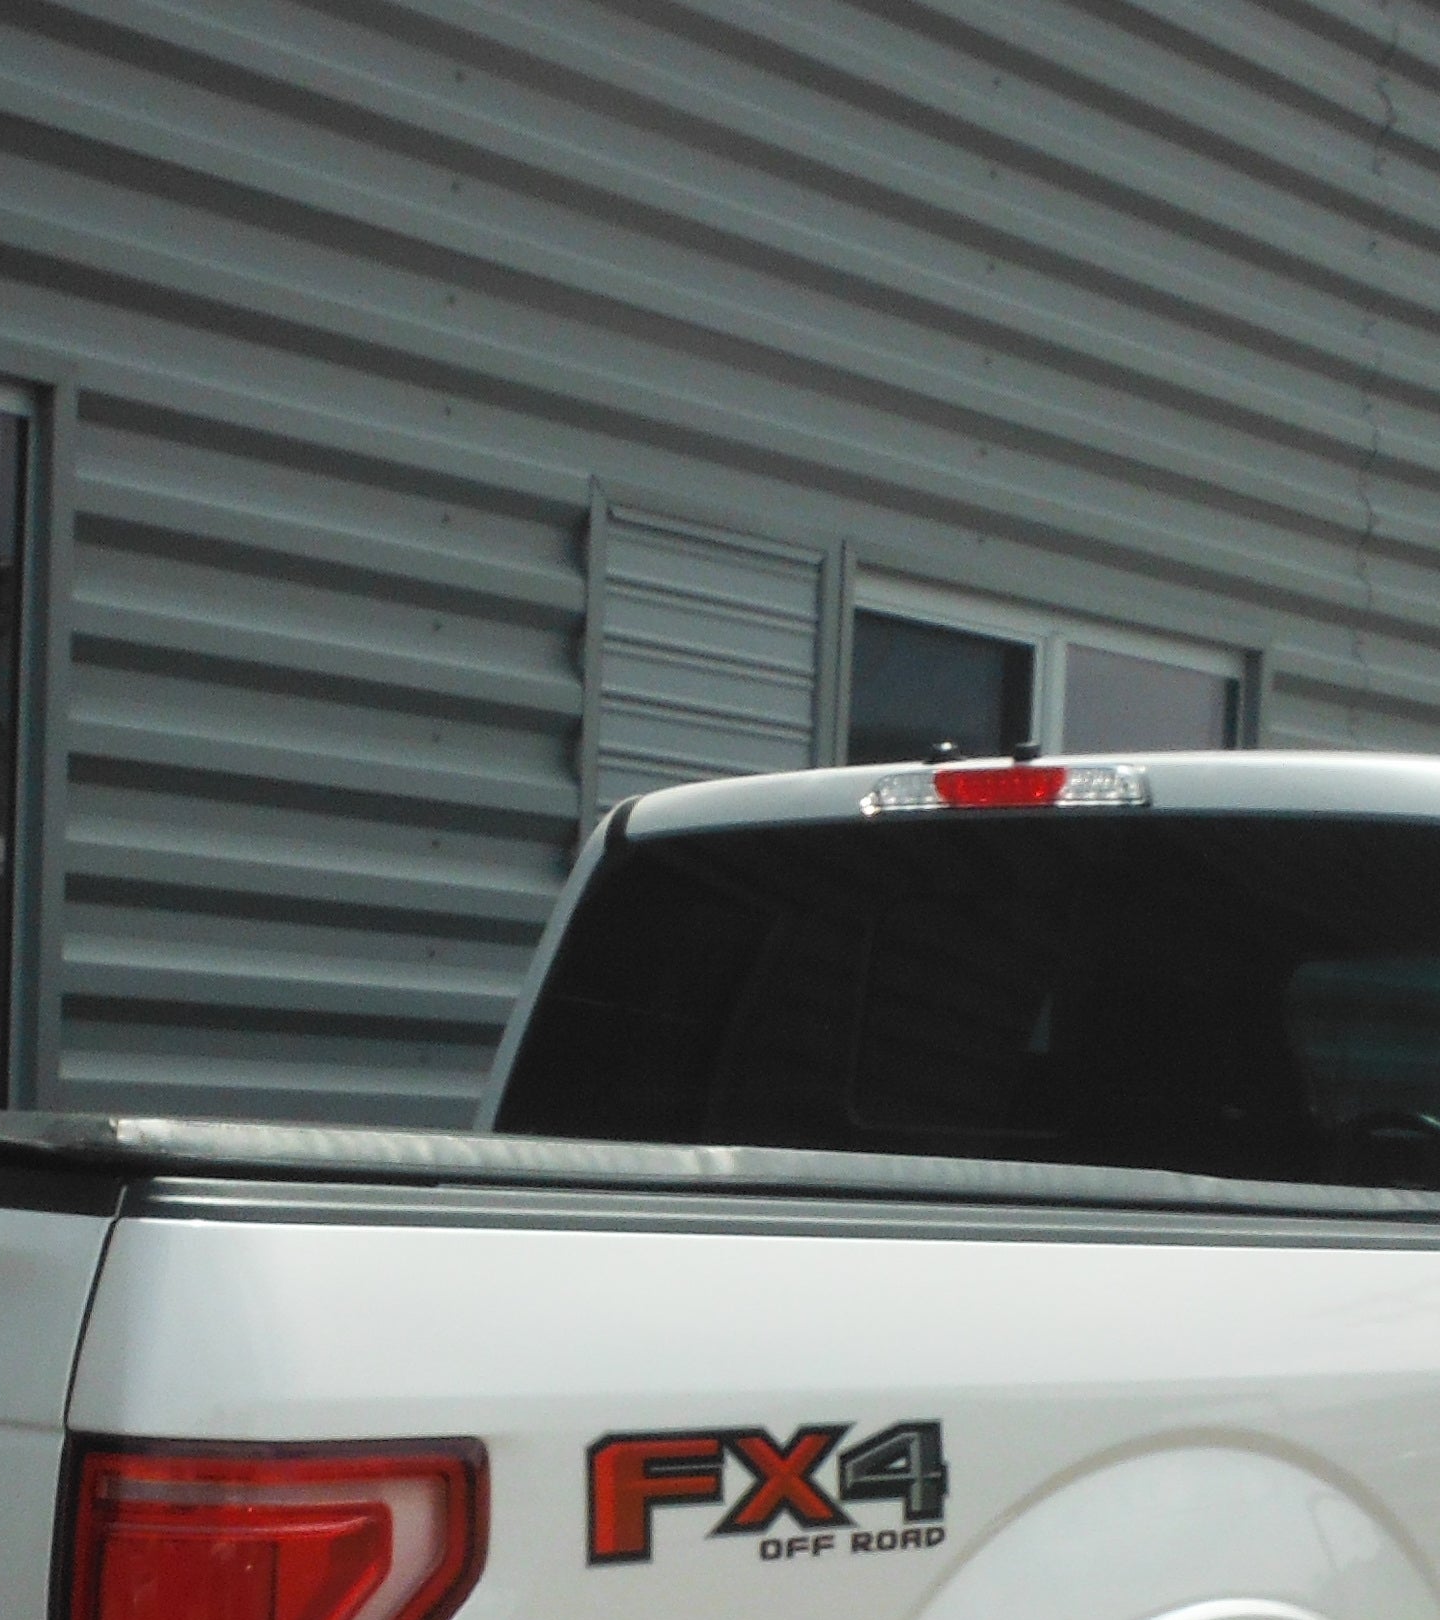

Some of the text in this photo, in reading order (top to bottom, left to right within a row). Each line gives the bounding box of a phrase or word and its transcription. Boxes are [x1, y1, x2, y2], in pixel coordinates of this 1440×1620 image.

[587, 1418, 949, 1567] FX4
[760, 1525, 946, 1561] OFF ROAD
